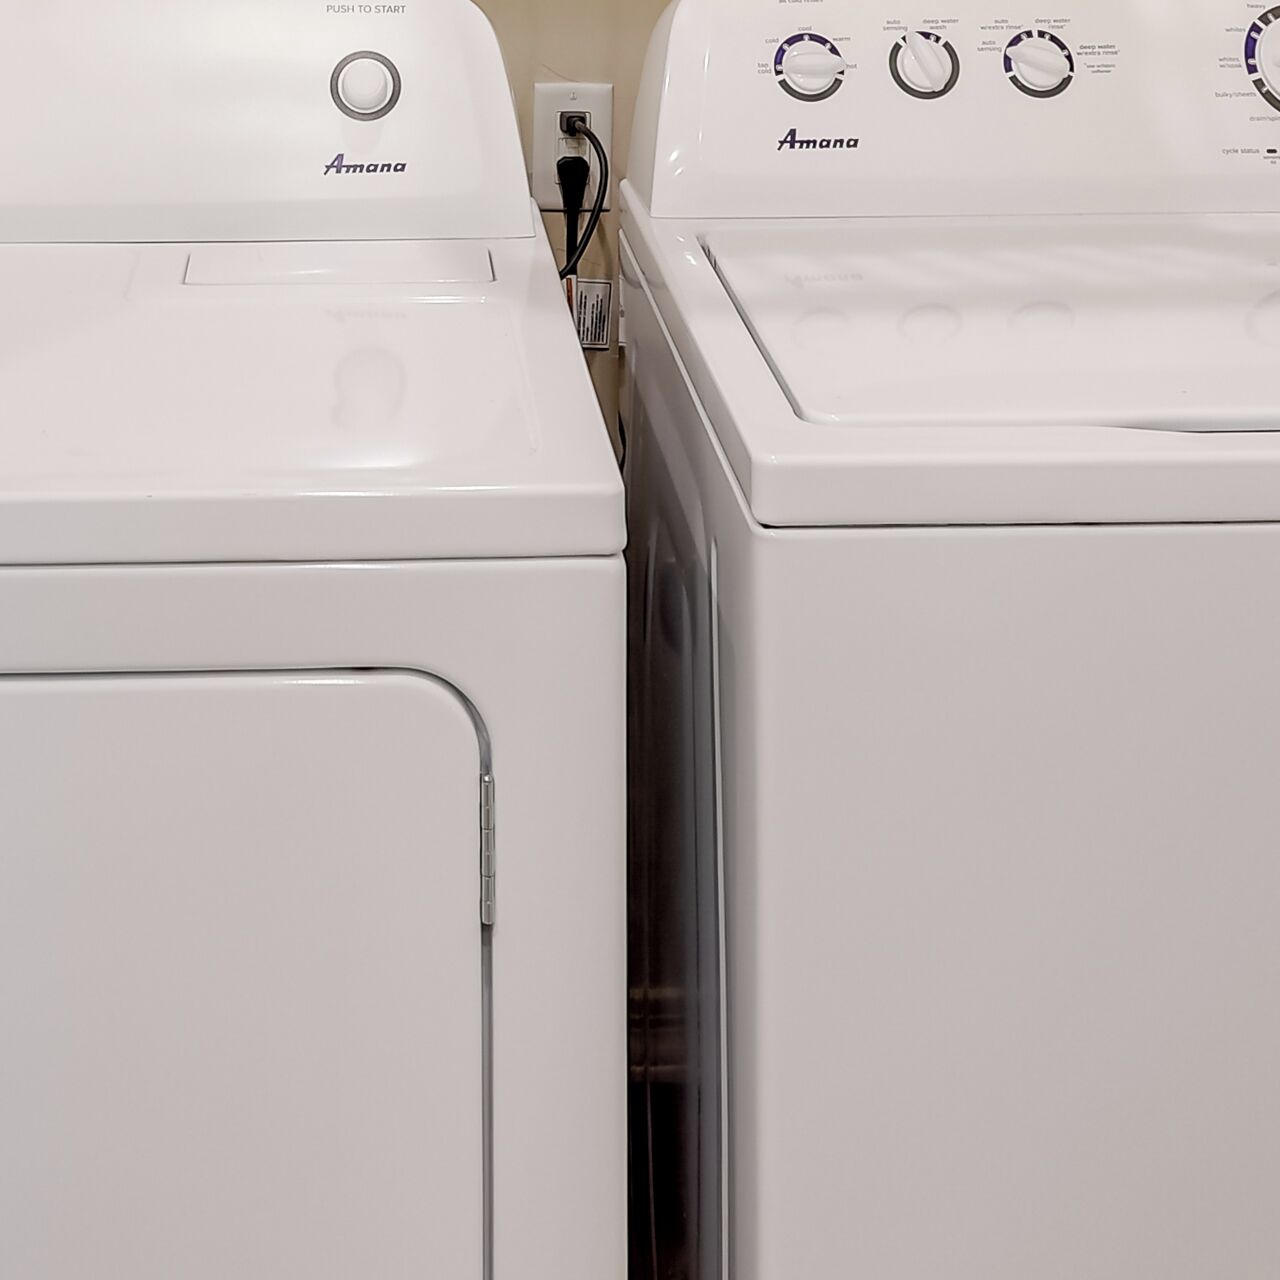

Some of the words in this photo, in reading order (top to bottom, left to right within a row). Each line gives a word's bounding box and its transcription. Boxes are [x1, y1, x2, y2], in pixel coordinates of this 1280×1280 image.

[326, 5, 355, 14] PUSH
[358, 5, 372, 14] TO
[374, 5, 407, 14] START
[777, 128, 860, 151] Amana
[323, 153, 407, 176] Amana
